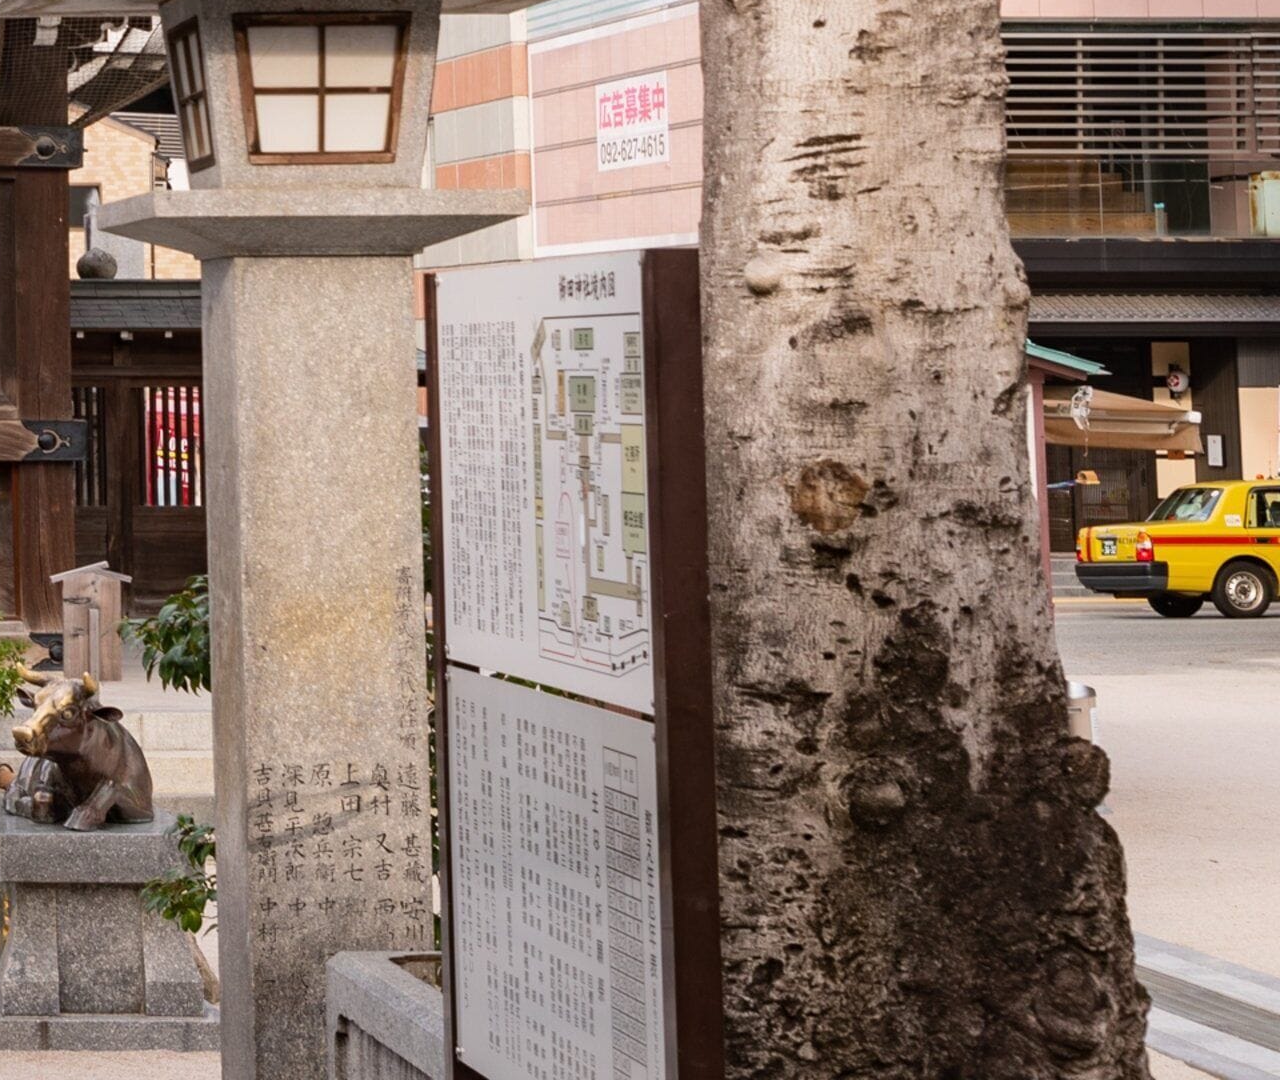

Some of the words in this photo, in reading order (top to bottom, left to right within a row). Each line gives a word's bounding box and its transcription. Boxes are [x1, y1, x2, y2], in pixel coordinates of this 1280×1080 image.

[598, 82, 665, 129] 広告募集中
